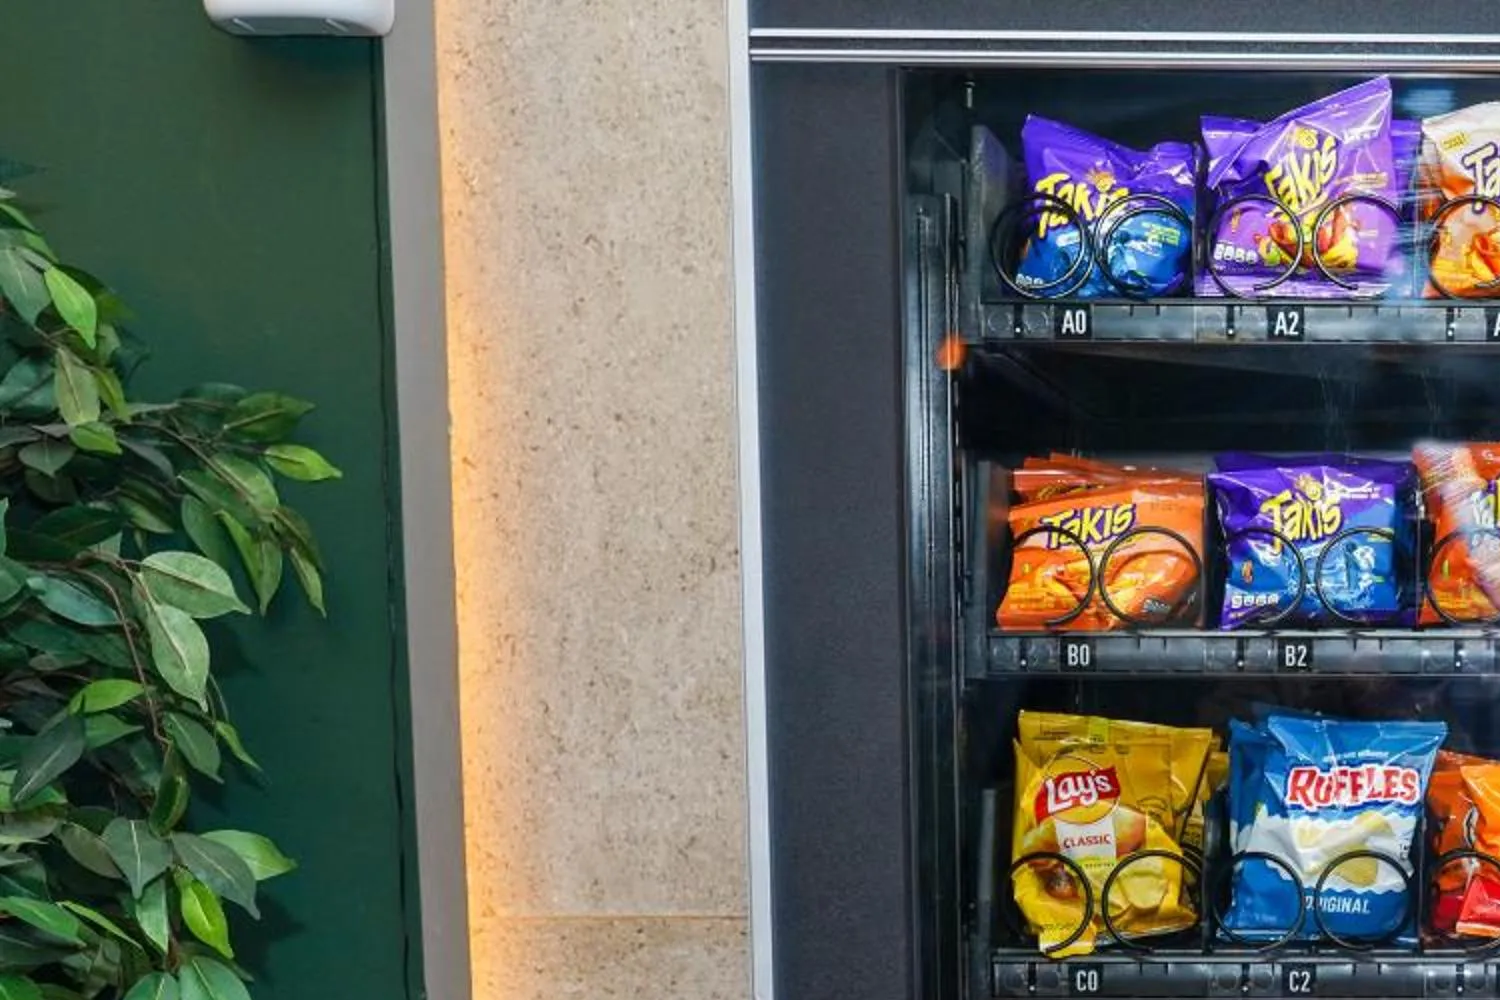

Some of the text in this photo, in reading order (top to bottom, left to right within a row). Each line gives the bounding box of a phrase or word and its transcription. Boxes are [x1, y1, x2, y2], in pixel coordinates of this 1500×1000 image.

[1061, 309, 1087, 335] A0
[1274, 311, 1299, 336] A2
[1041, 503, 1136, 549] Takis
[1261, 486, 1343, 554] Takis
[1067, 643, 1090, 666] B0
[1285, 644, 1307, 667] B2
[1045, 770, 1113, 814] Lay's
[1063, 833, 1113, 849] CLASSIC
[1076, 969, 1098, 992] C0
[1289, 970, 1311, 992] C2
